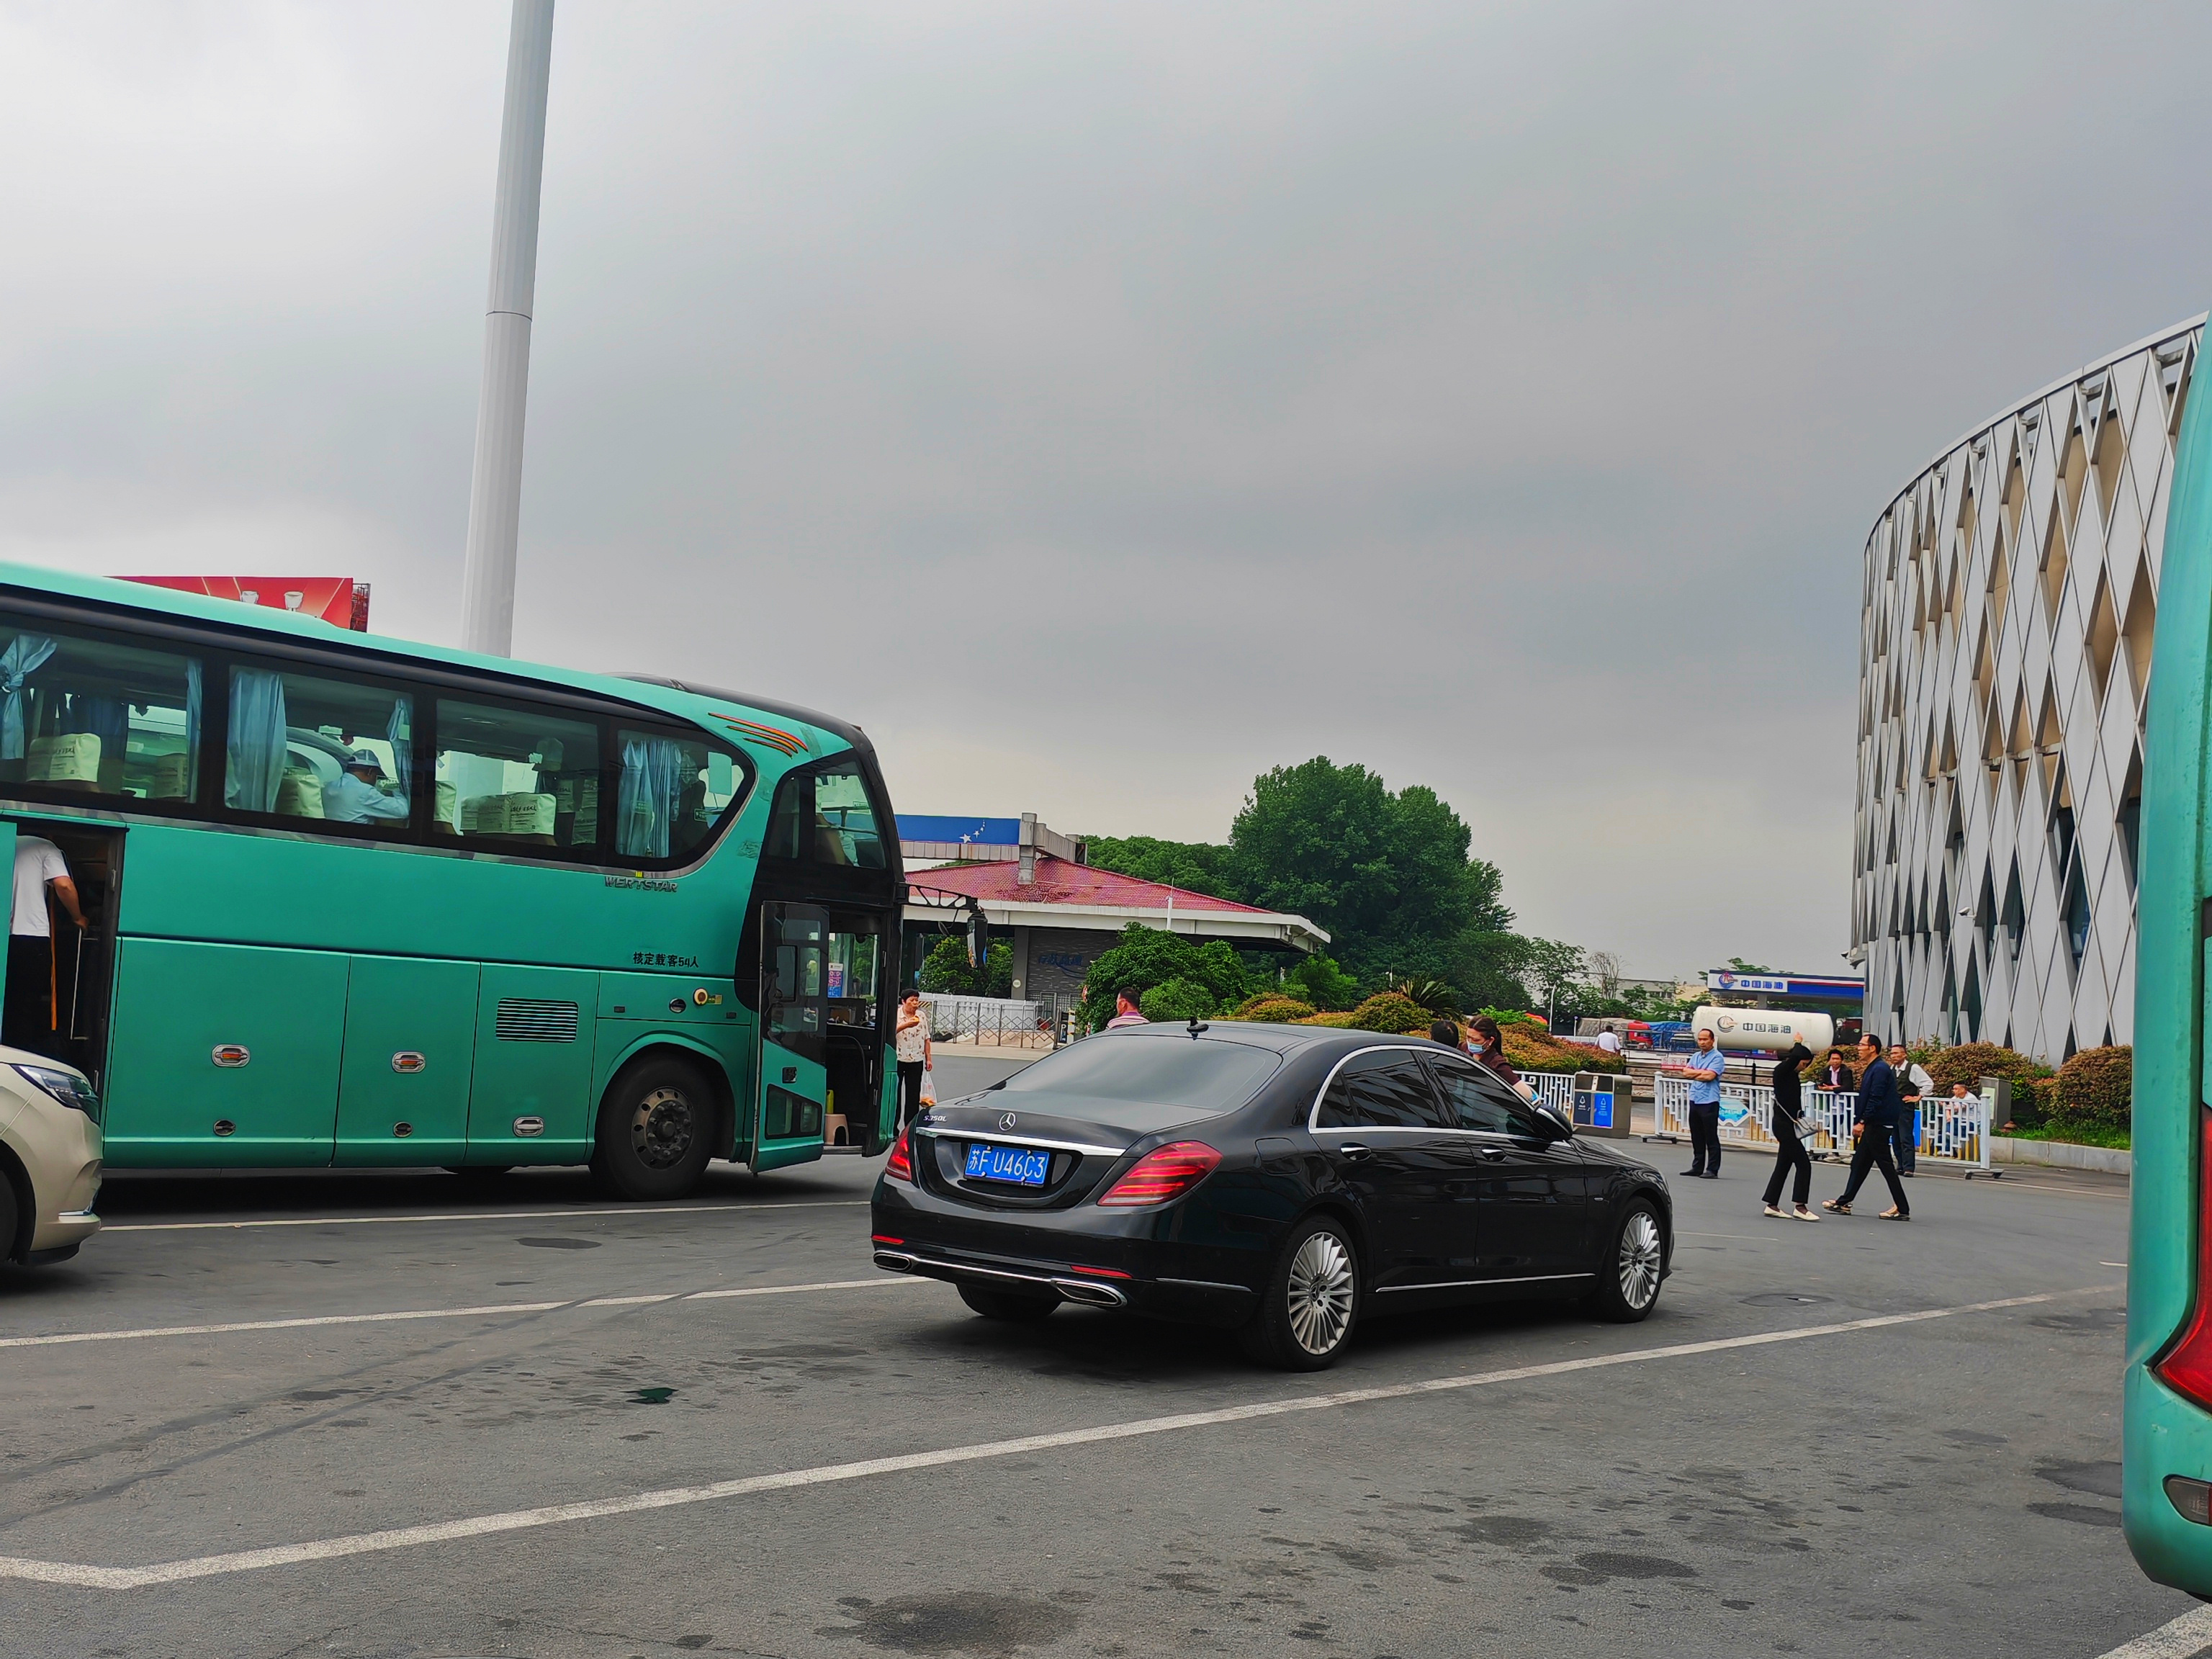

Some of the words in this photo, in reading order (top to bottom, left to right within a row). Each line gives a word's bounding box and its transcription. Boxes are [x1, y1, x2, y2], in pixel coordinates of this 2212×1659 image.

[633, 952, 699, 968] 核定载客54人
[1740, 979, 1784, 989] 中国海油
[1743, 1022, 1791, 1034] 中国海油
